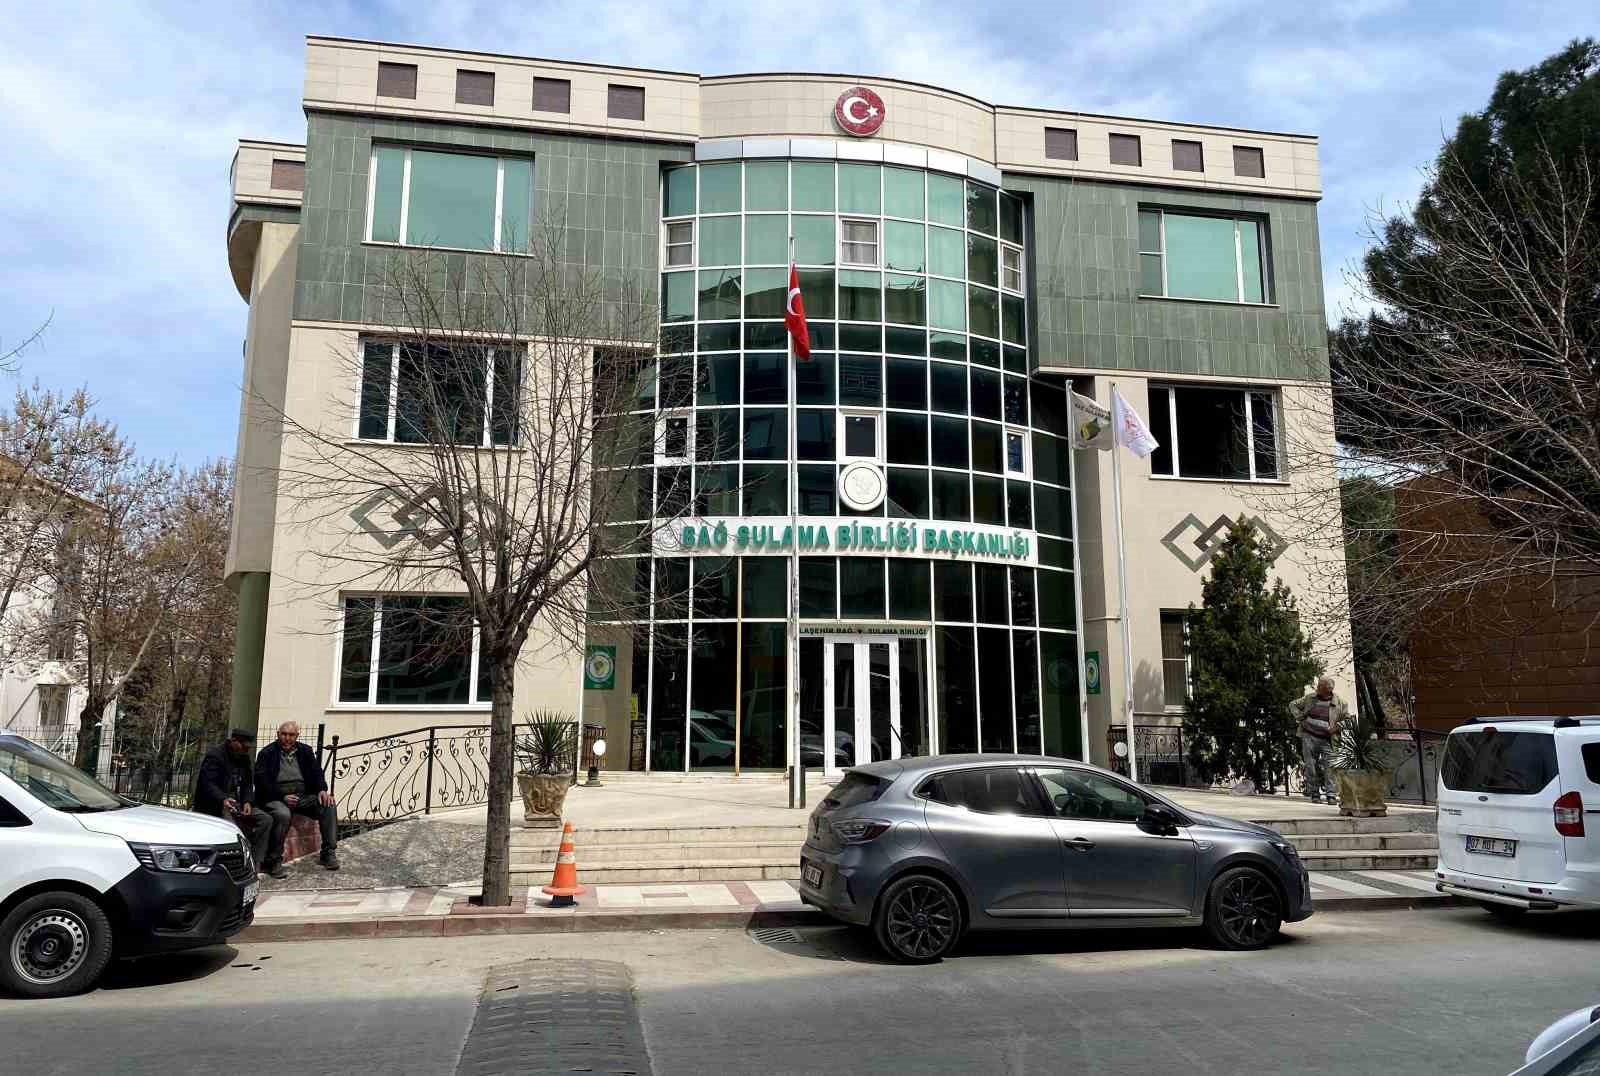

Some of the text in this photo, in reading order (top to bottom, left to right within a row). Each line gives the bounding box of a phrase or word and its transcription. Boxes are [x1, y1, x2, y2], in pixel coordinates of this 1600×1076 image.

[682, 519, 1030, 559] BAĞ SULAMA BİRLİĞİ BAŞKANLIĞI
